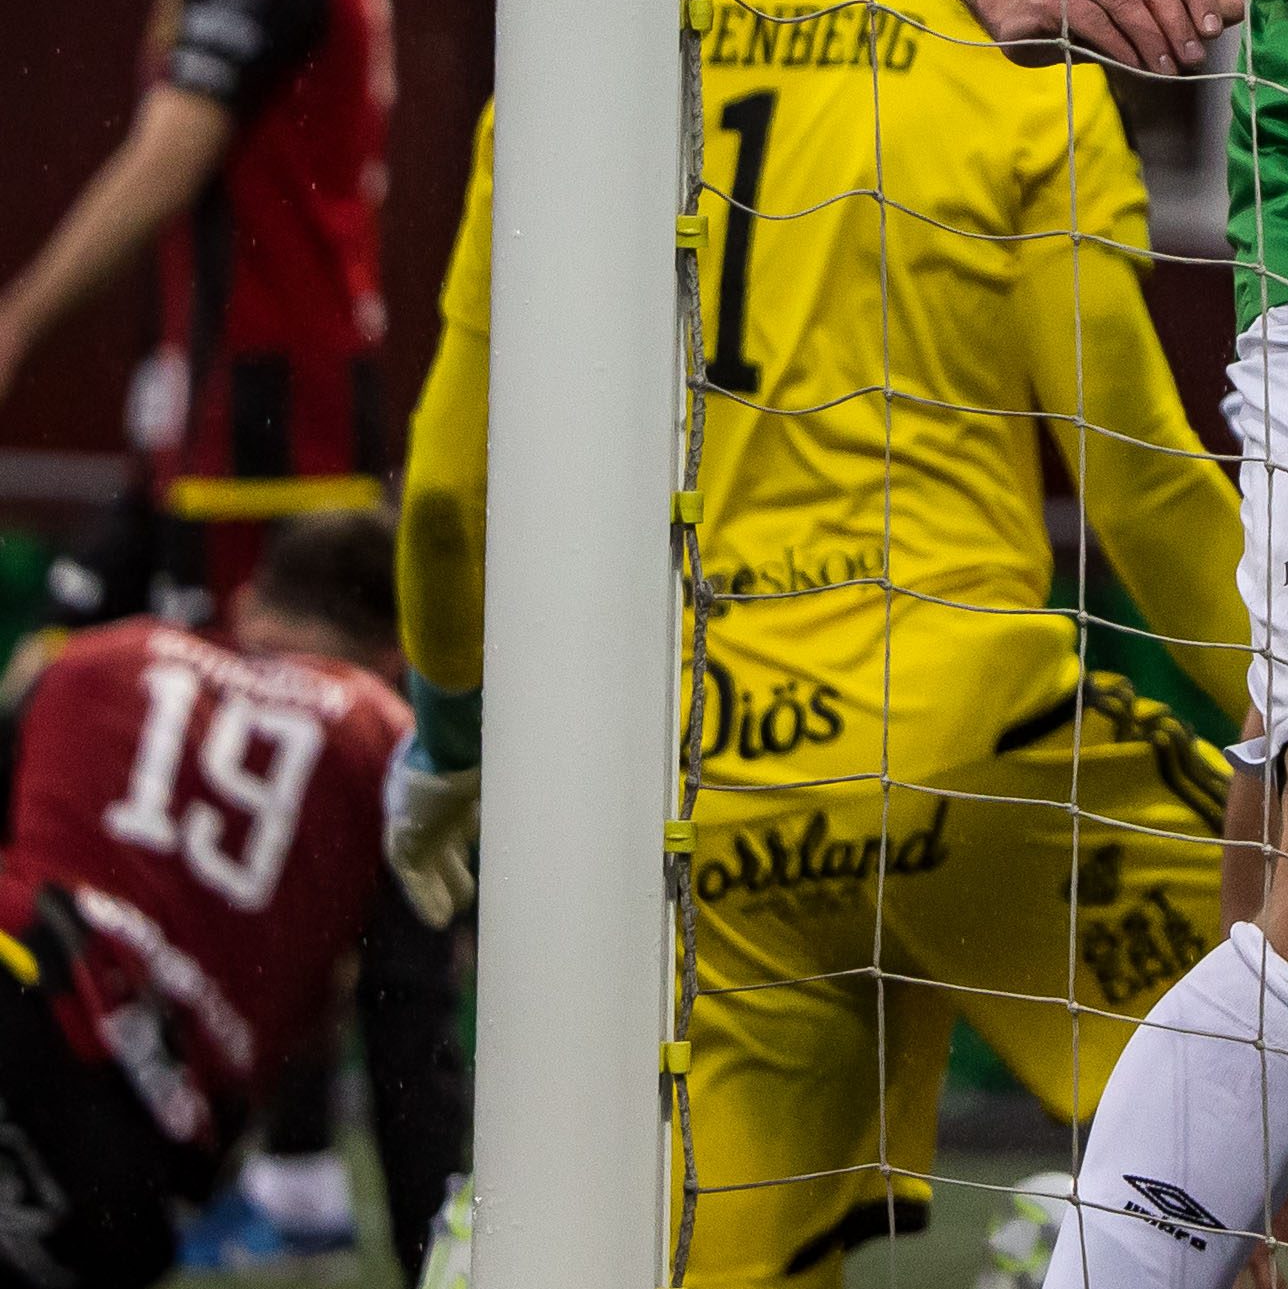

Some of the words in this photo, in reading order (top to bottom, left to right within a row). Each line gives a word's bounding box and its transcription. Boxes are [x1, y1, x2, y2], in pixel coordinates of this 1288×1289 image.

[704, 2, 926, 75] ENBERG
[704, 87, 781, 394] 1
[101, 665, 328, 911] 19
